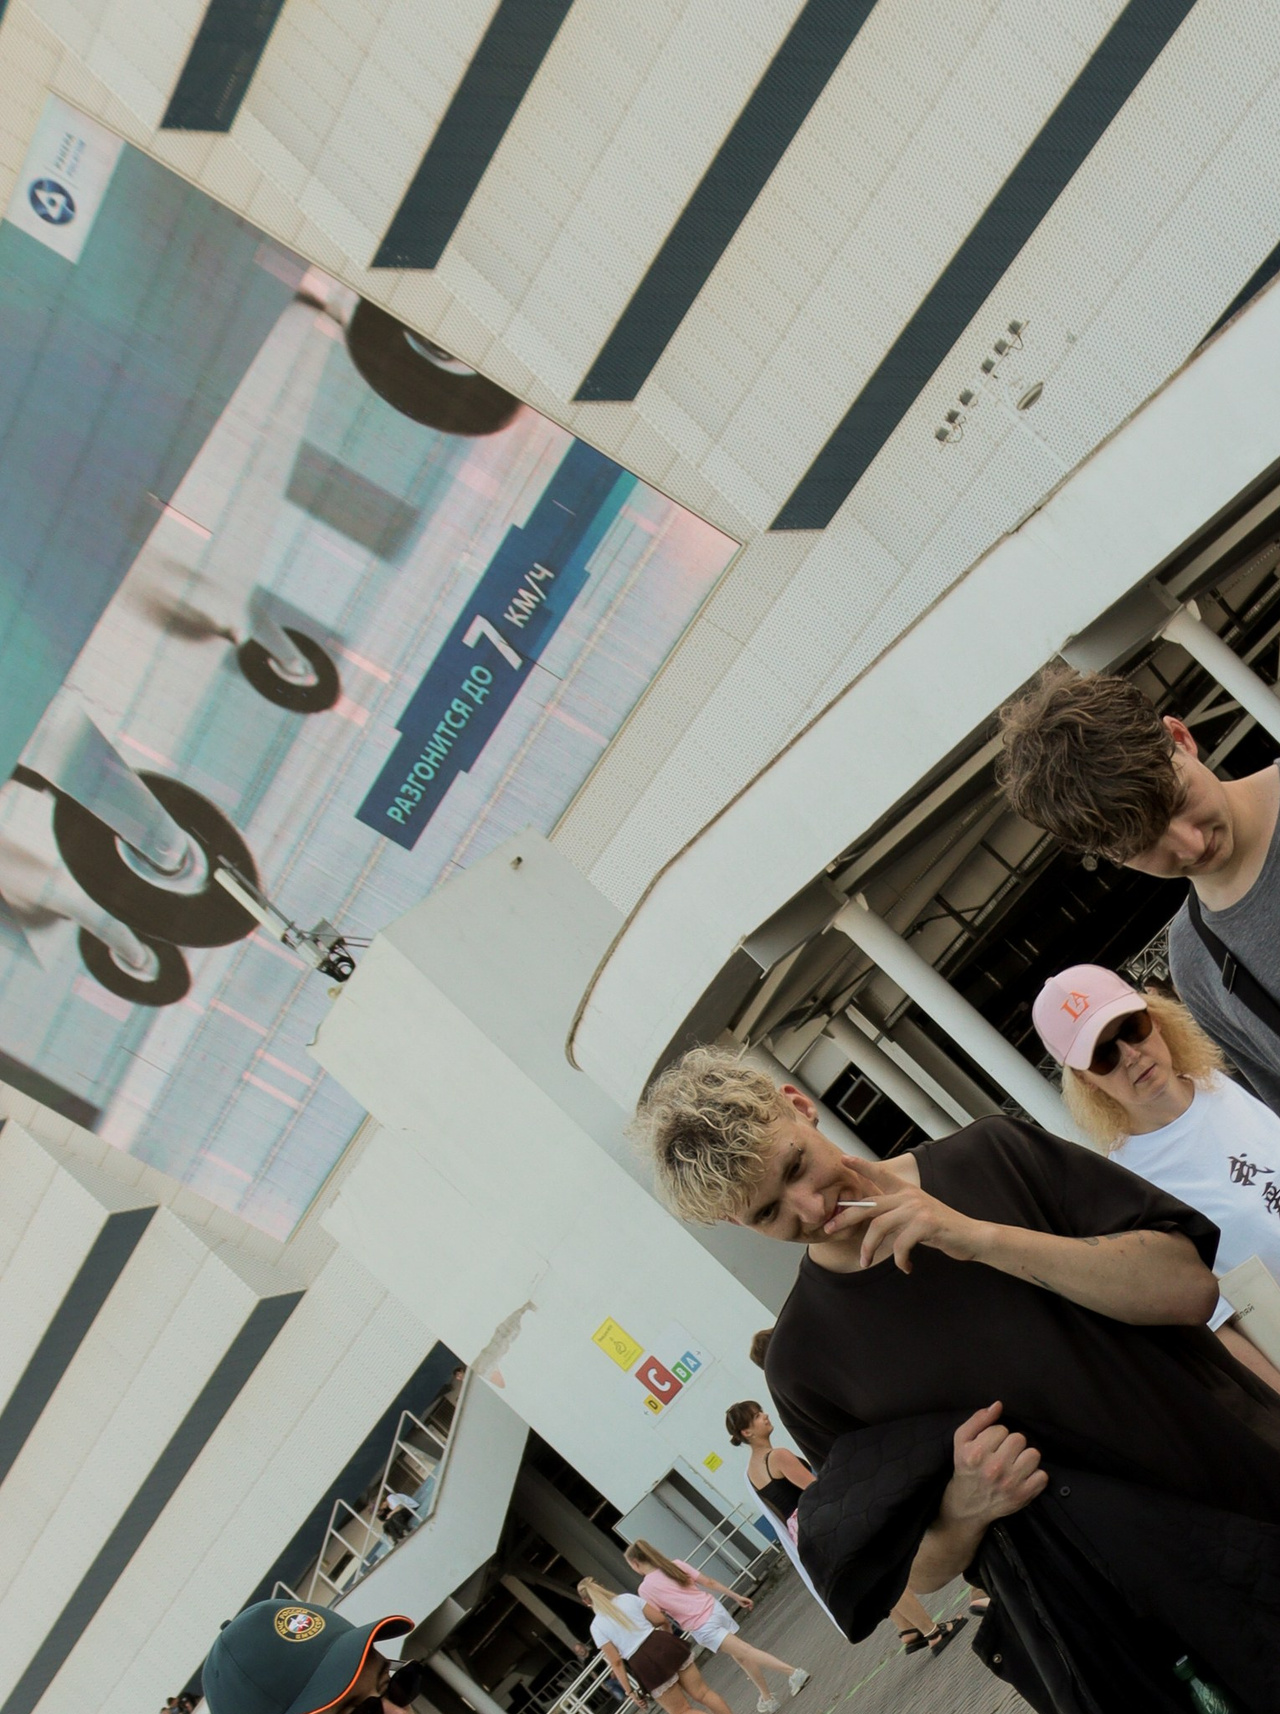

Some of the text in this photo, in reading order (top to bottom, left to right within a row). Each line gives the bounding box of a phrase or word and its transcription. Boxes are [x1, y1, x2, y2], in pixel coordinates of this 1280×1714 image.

[386, 562, 555, 825] РАЗГОНИТСЯ ДО 7 КМ/Ч
[647, 1356, 698, 1411] D C B A
